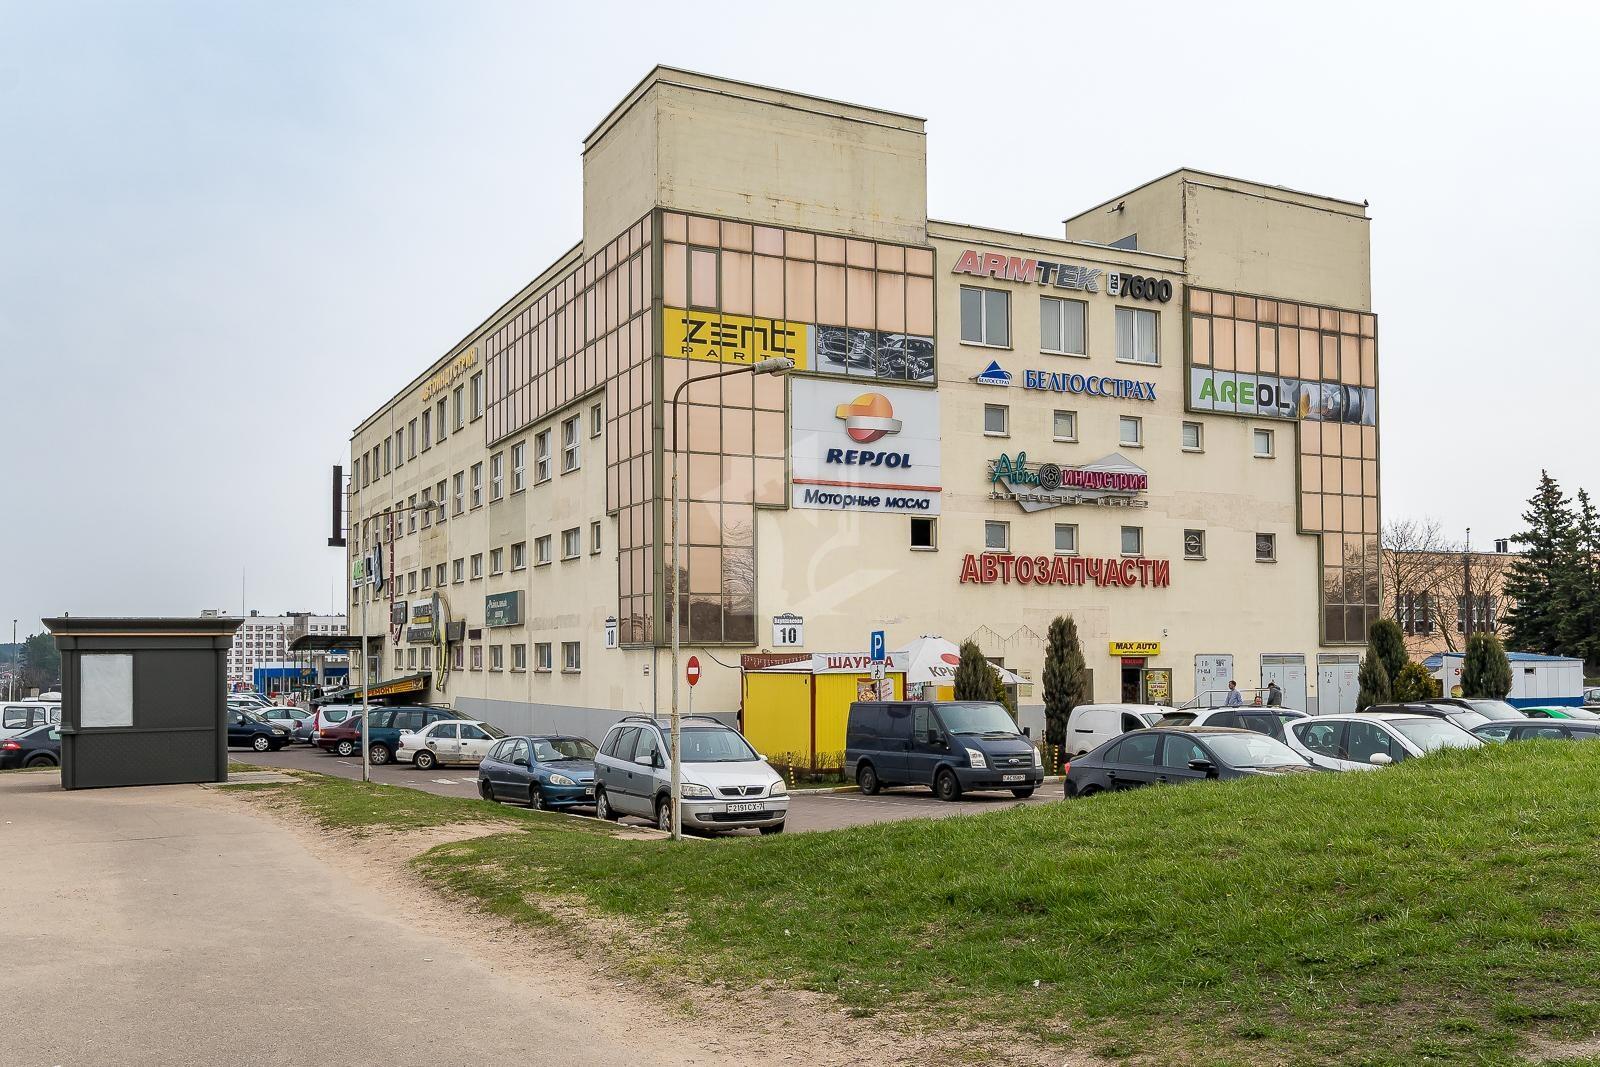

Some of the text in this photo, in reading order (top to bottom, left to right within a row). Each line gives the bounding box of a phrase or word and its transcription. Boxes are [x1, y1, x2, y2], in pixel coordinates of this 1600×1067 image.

[951, 249, 1102, 293] ARMTEK
[1120, 273, 1173, 302] 7600
[978, 377, 1010, 386] БЕЛГОССТРАХ
[1024, 369, 1157, 401] БЕЛГОССТРАХ
[1199, 377, 1290, 408] AREOL
[826, 448, 912, 469] REPSOL
[804, 489, 930, 510] Моторные масла
[960, 553, 1171, 588] АВТОЗАПЧАСТИ
[608, 629, 615, 646] 10
[780, 627, 797, 643] 10
[1115, 642, 1158, 650] MAX AUTO
[828, 656, 894, 669] ШАУРА
